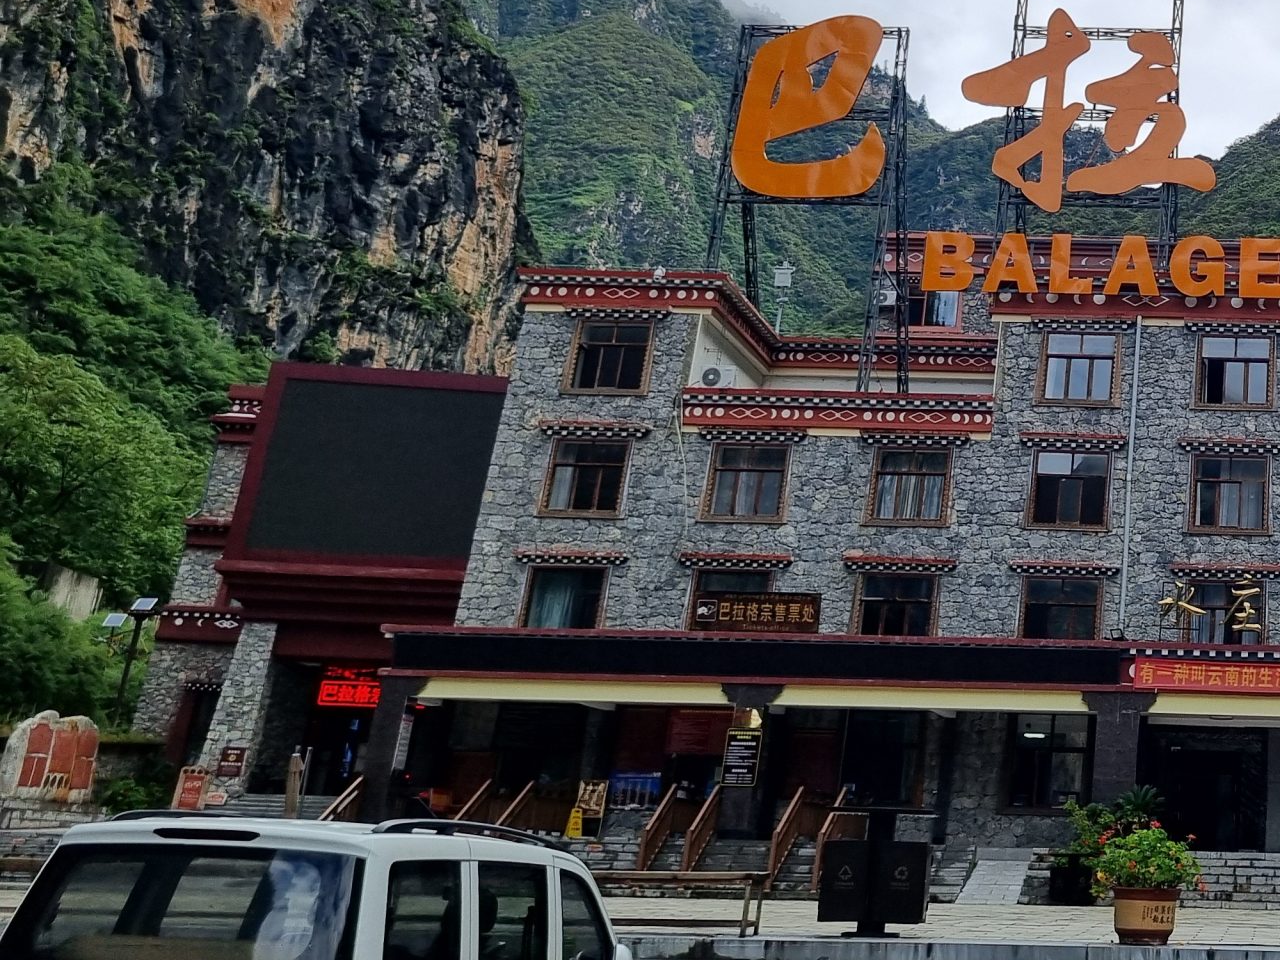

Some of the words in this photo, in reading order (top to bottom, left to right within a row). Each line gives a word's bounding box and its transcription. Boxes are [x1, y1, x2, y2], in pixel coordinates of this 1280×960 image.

[719, 602, 815, 622] 巴拉格宗售票处
